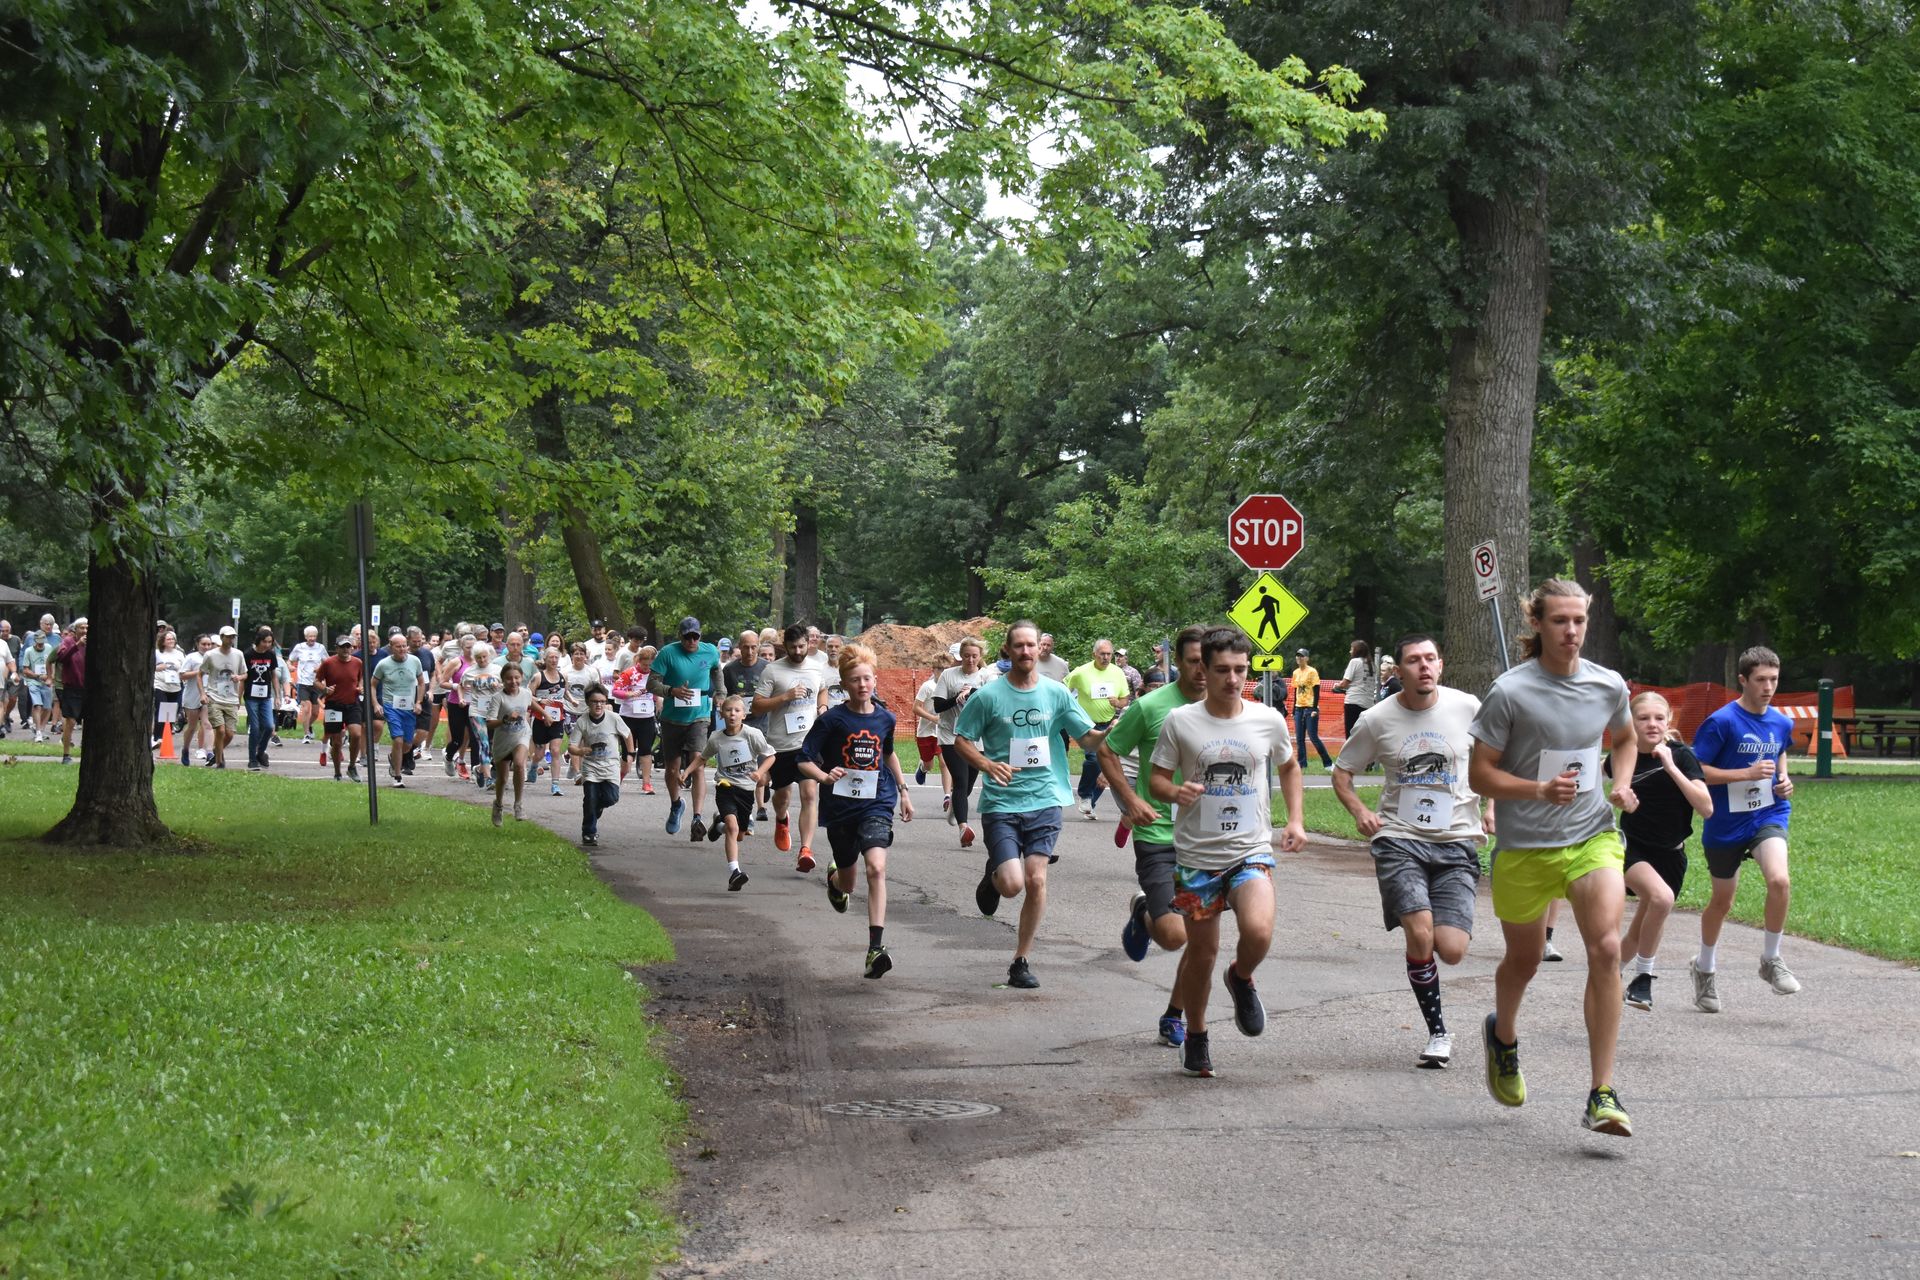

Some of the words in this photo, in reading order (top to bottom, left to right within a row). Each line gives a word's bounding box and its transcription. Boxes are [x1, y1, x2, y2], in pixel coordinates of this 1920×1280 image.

[1234, 518, 1298, 546] STOP
[1012, 708, 1041, 727] EC
[1222, 738, 1250, 751] ANNUAL
[1027, 757, 1039, 765] 90
[851, 789, 861, 797] 91
[1748, 799, 1761, 809] 193
[1417, 814, 1431, 824] 44
[1220, 822, 1239, 831] 157
